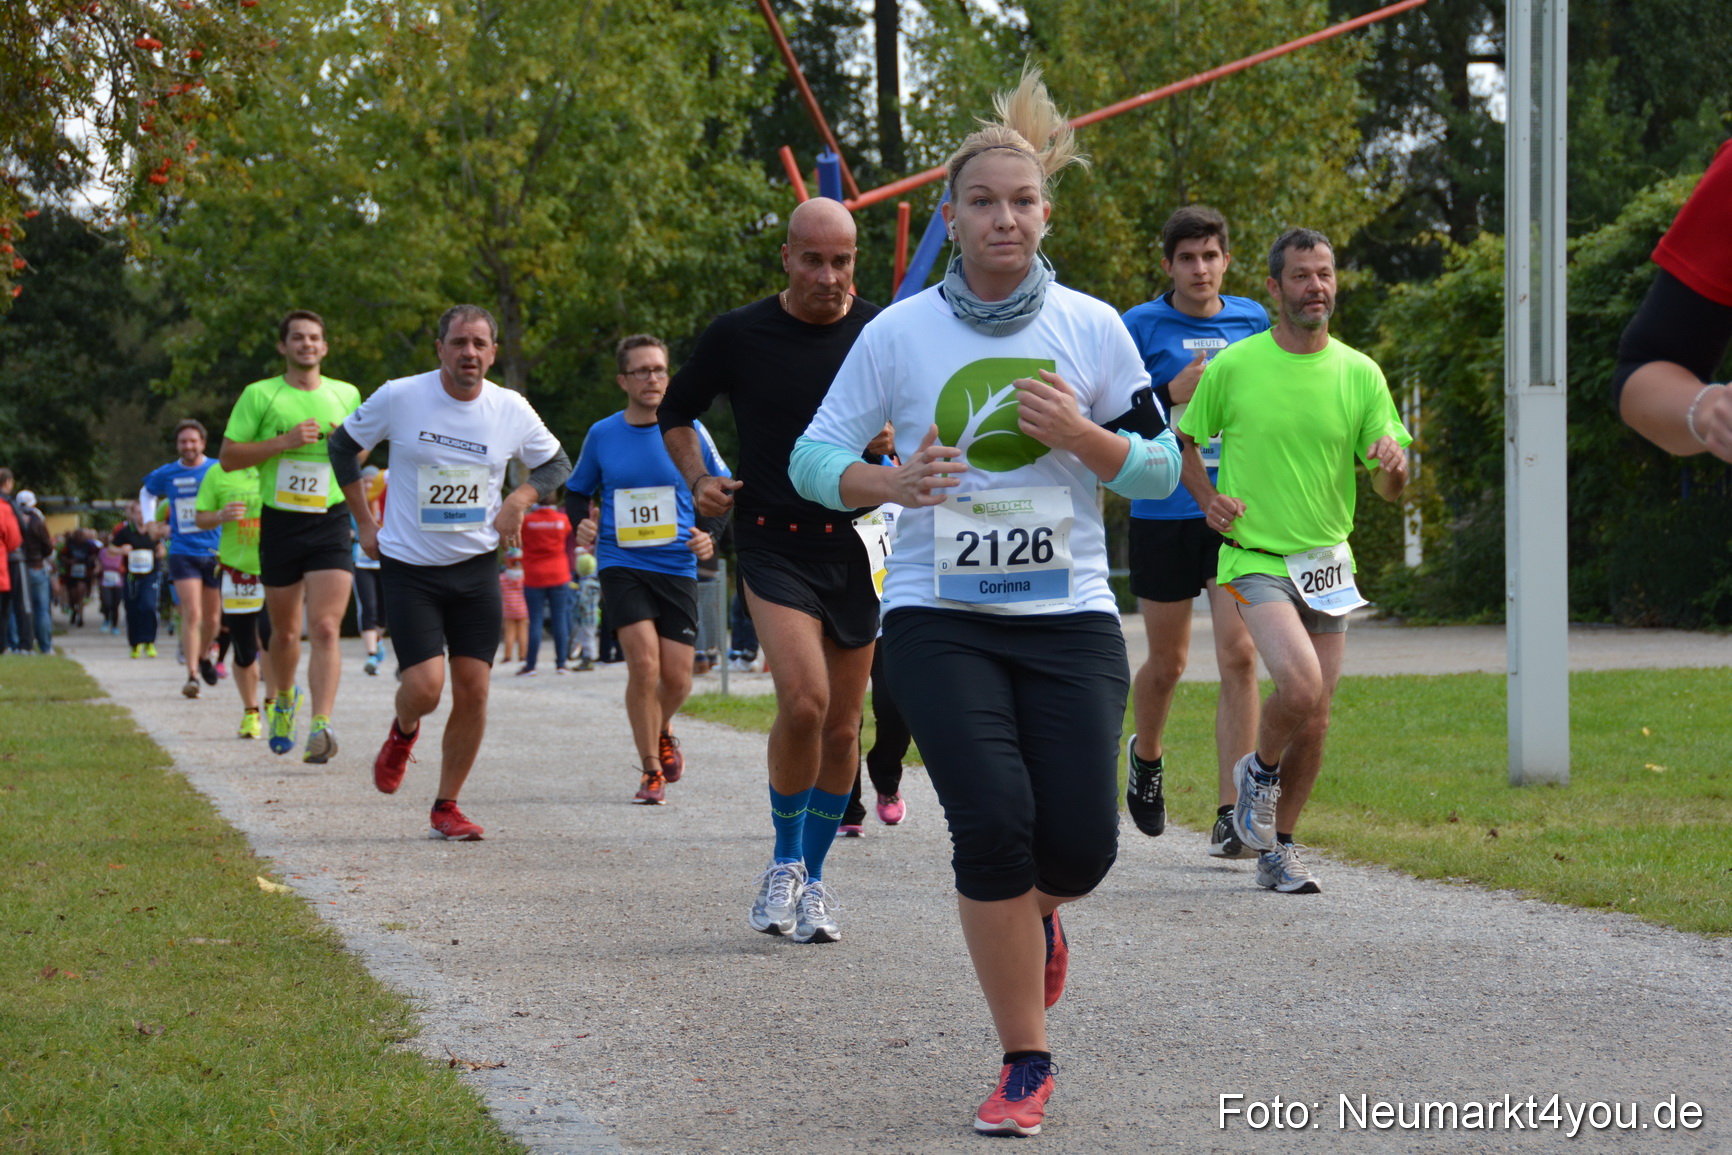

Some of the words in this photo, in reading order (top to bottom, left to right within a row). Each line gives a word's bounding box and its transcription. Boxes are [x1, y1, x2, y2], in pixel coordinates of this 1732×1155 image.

[1193, 339, 1221, 348] HEUTE
[289, 476, 319, 492] 212
[429, 484, 479, 504] 2224
[630, 505, 659, 524] 191
[986, 500, 1034, 513] BOCK
[956, 527, 1054, 567] 2126
[979, 580, 1031, 594] Corinna
[1300, 563, 1342, 594] 2601
